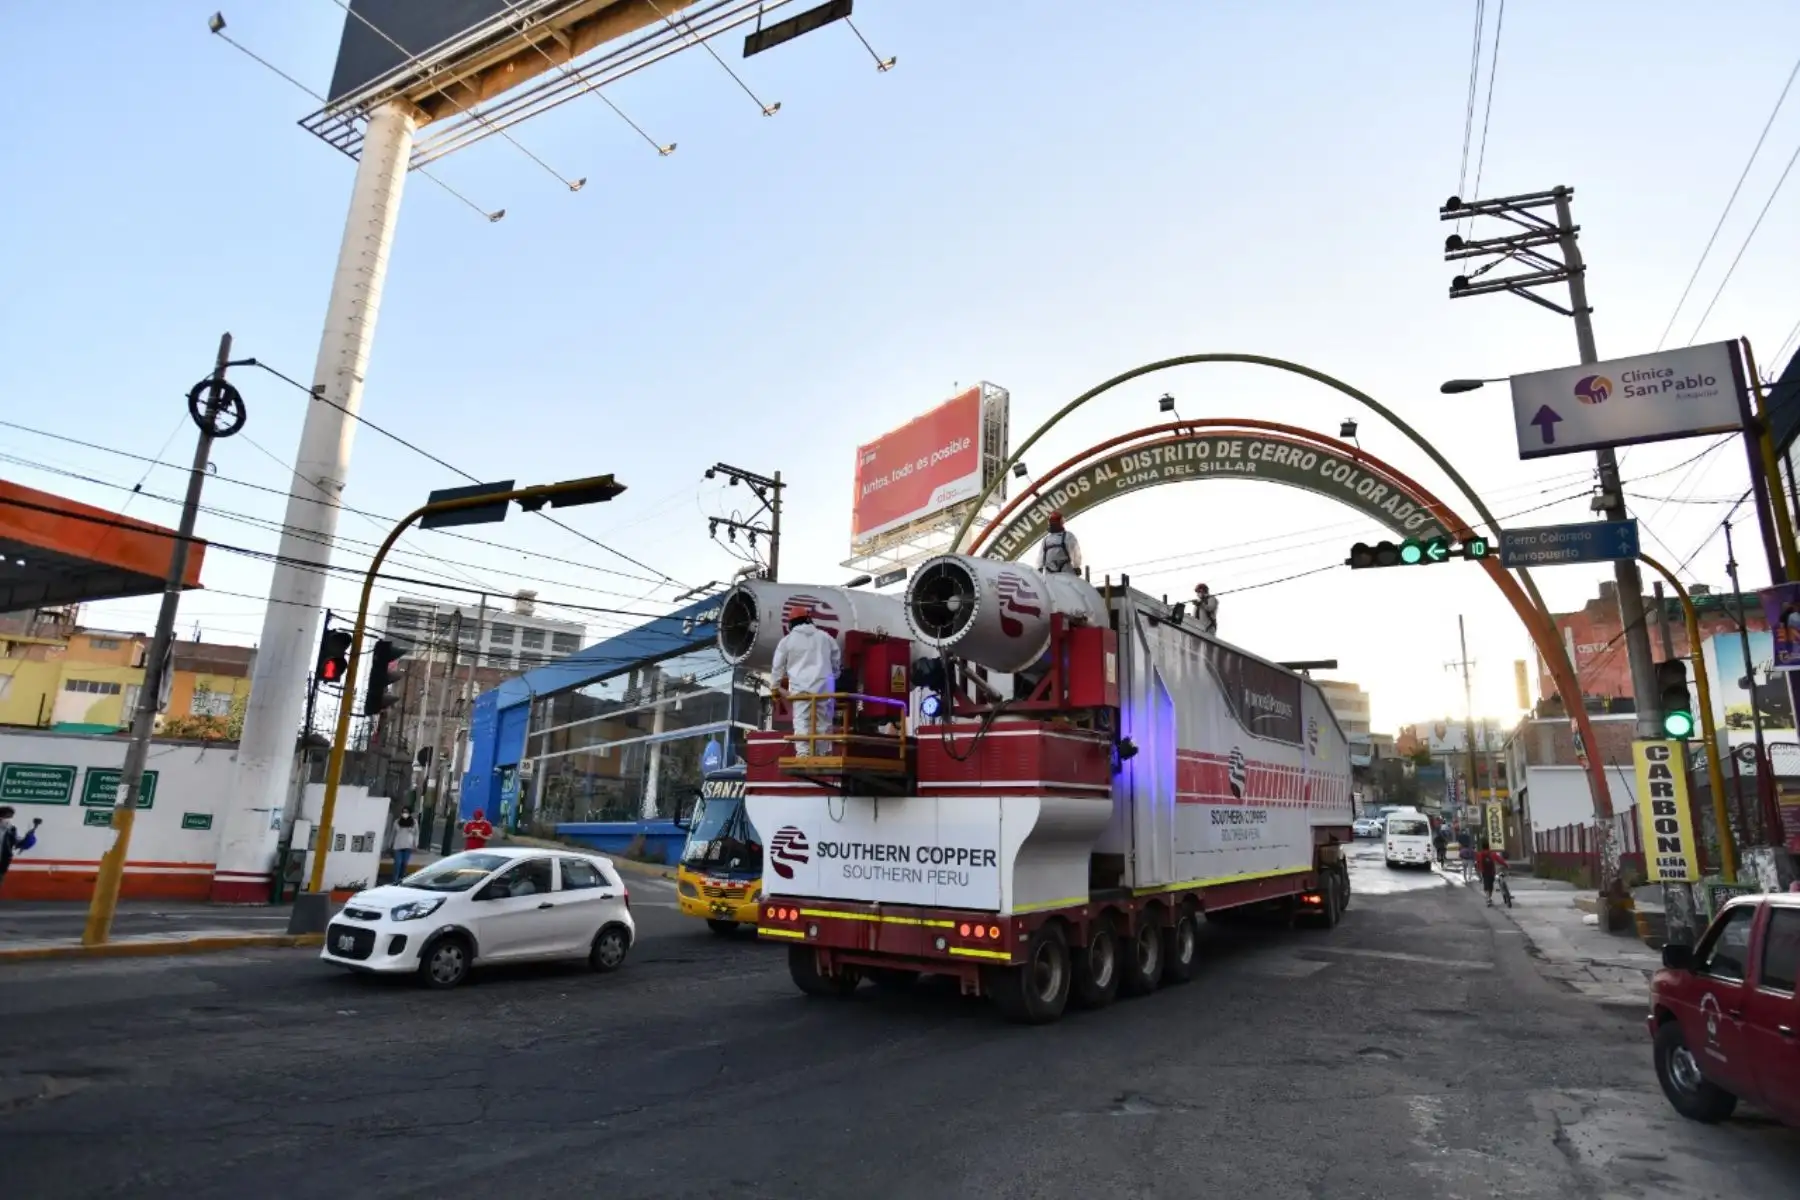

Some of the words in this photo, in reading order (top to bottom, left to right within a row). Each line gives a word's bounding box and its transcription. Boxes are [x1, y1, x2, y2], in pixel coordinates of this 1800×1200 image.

[1624, 384, 1659, 398] San
[1661, 373, 1716, 393] Pablo
[916, 456, 929, 470] es
[930, 436, 972, 467] posible
[1116, 469, 1160, 489] CUNA
[1164, 462, 1195, 477] DEL
[1199, 460, 1257, 473] SILLAR
[988, 475, 1091, 562] BIENVENIDOS
[1094, 463, 1118, 485] AL
[1119, 440, 1210, 474] DISTRITO
[1215, 440, 1243, 458] DE
[1248, 441, 1317, 471] CERRO
[1319, 458, 1427, 531] COLORADO
[1471, 541, 1485, 555] 10
[1505, 535, 1538, 546] Cerro
[1539, 530, 1592, 544] Colorado
[1508, 548, 1579, 562] Aeropuerto
[1644, 745, 1682, 853] CARBON
[1211, 809, 1244, 825] SOUTHERN
[817, 841, 910, 863] SOUTHERN
[916, 846, 997, 868] COPPER
[843, 864, 923, 884] SOUTHERN
[927, 869, 970, 887] PERU
